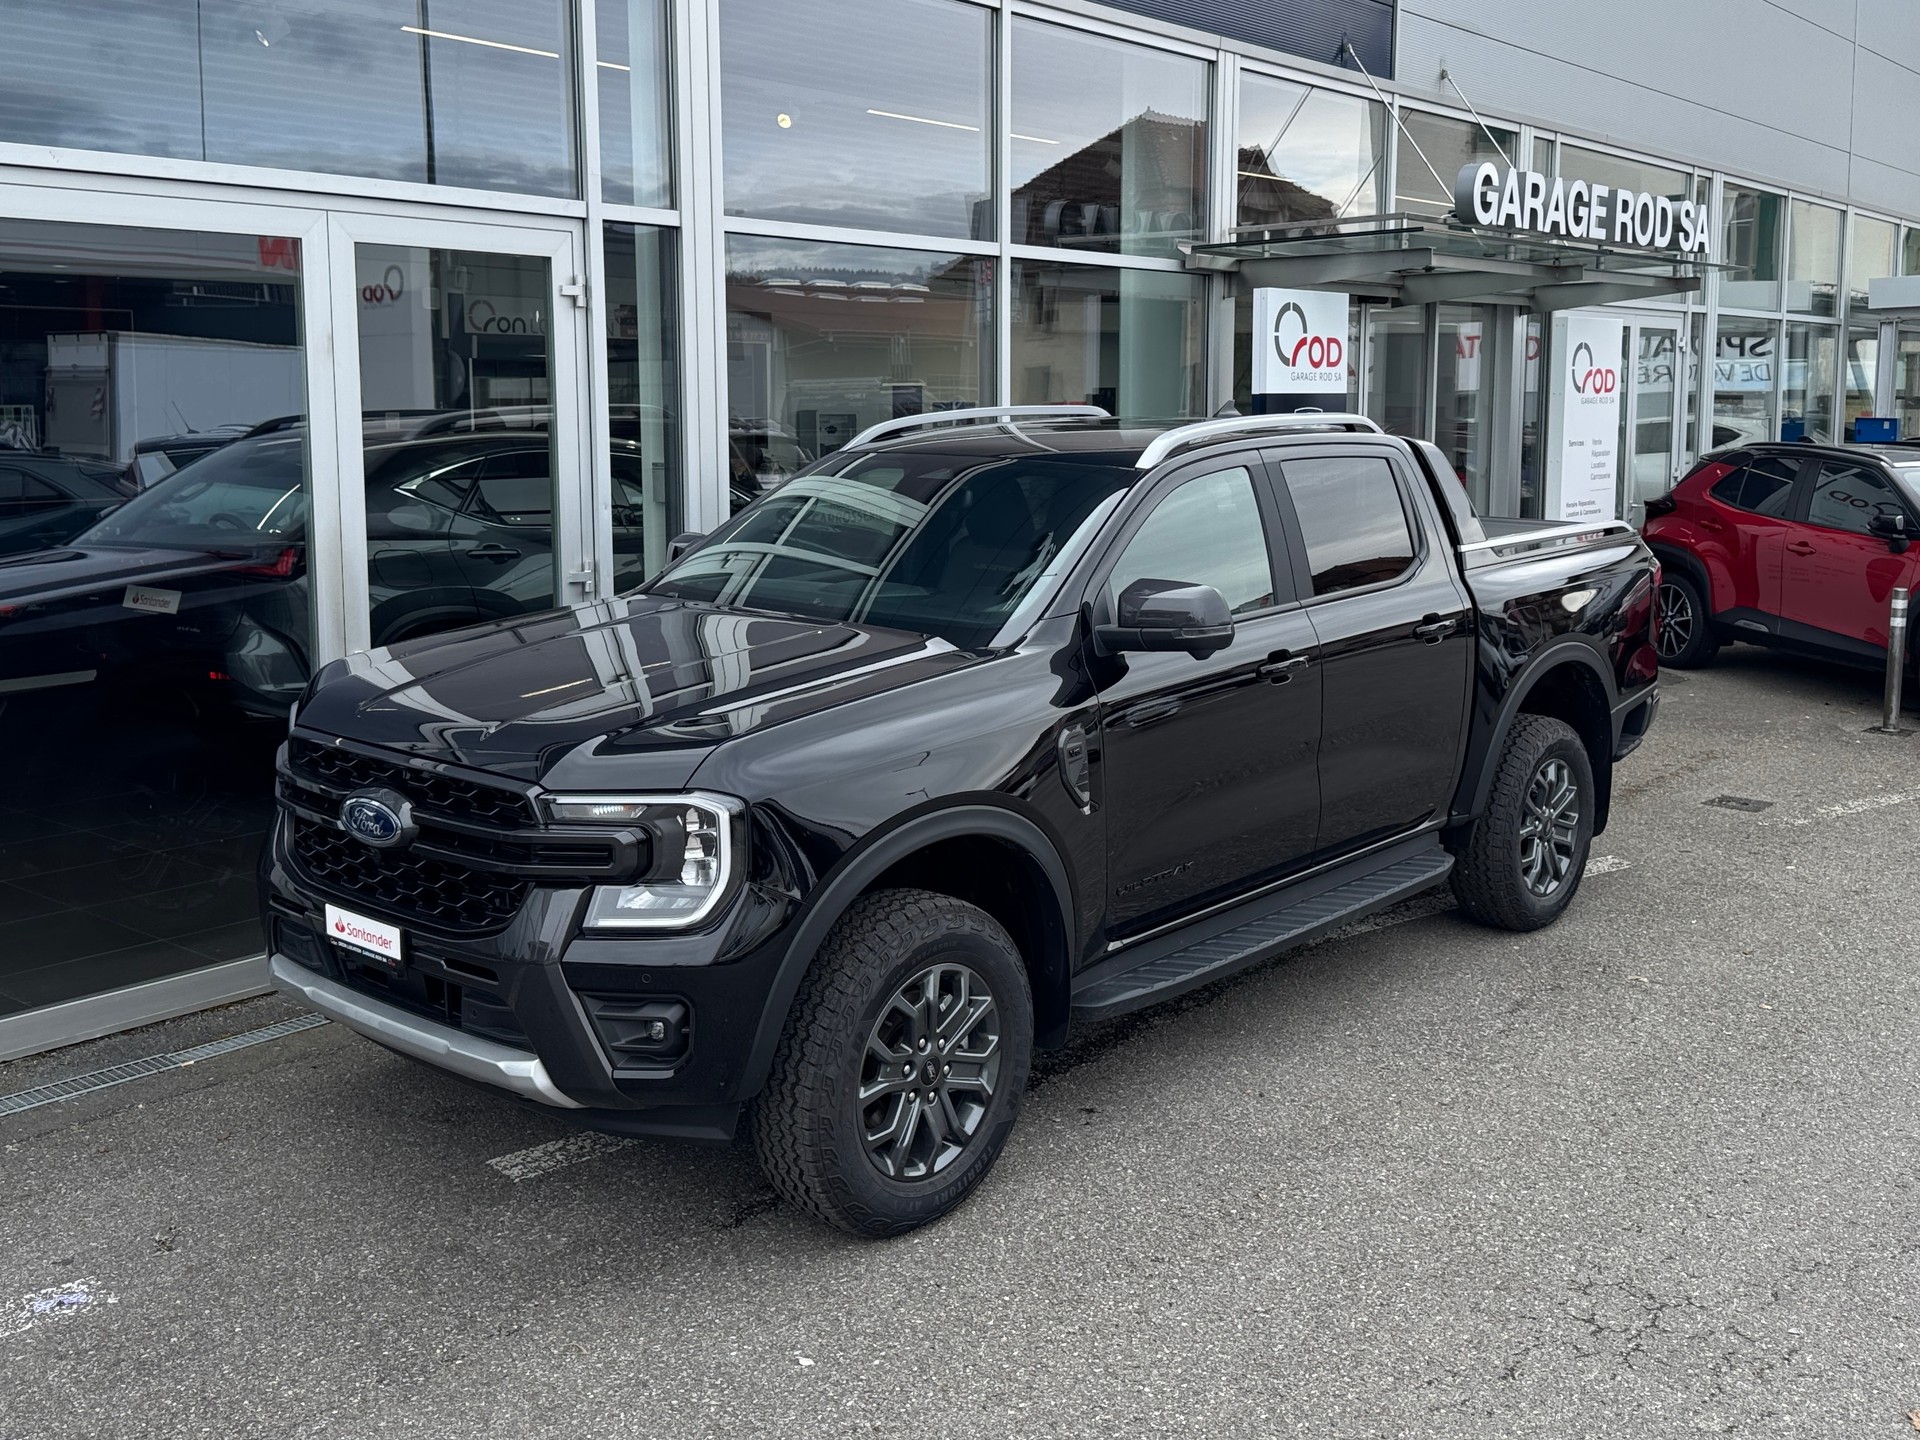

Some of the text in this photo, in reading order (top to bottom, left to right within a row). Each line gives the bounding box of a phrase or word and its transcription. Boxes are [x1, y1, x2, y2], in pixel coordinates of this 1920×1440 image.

[1473, 161, 1710, 254] GARAGE ROD SA
[1290, 371, 1342, 382] GARAGE ROD SA
[138, 594, 172, 609] Santander
[351, 806, 385, 836] Ford
[346, 922, 393, 950] Santander
